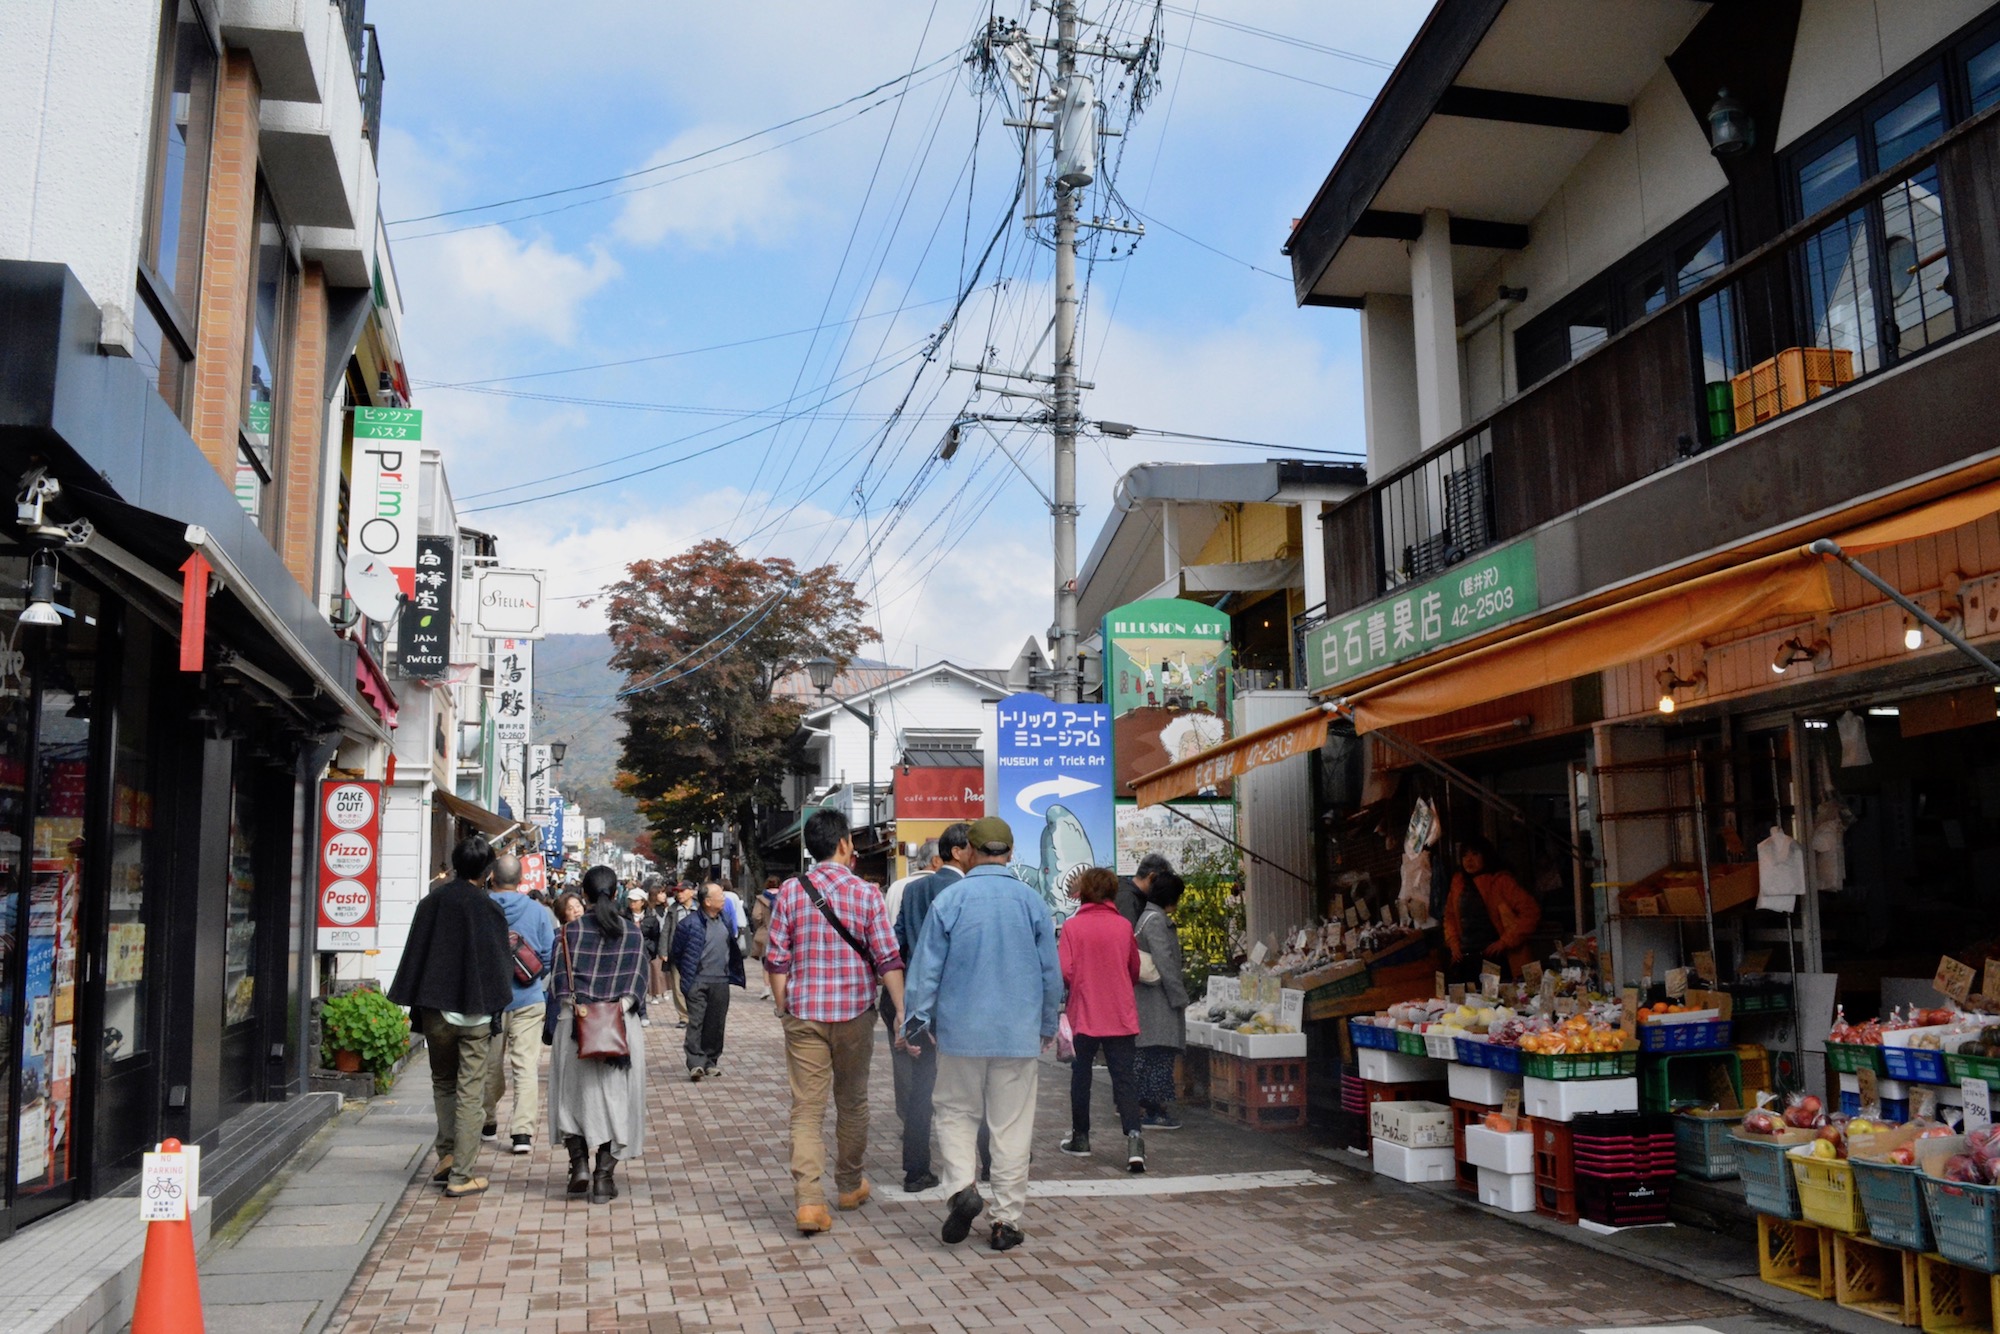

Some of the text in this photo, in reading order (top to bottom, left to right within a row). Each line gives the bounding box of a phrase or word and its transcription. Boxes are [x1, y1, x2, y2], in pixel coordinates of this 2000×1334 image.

[364, 408, 414, 422] ピッツァ
[369, 425, 408, 438] パスタ
[1459, 566, 1499, 598] (軽井沢)
[1450, 586, 1514, 628] 42-2503
[1114, 622, 1223, 635] ILLUSION ART
[1321, 590, 1443, 677] 白石青果店
[413, 634, 438, 643] JAM
[420, 644, 429, 653] &
[406, 654, 443, 664] SWEETS
[1000, 711, 1106, 728] トリック アート
[1014, 730, 1100, 747] ミュージアム
[999, 755, 1105, 766] MUSEUM of Trick Art
[337, 792, 364, 802] TAKE
[336, 802, 364, 812] OUT!
[329, 843, 368, 857] Pizza
[326, 891, 367, 904] Pasta
[160, 1154, 172, 1162] NO
[147, 1166, 184, 1174] PARKING
